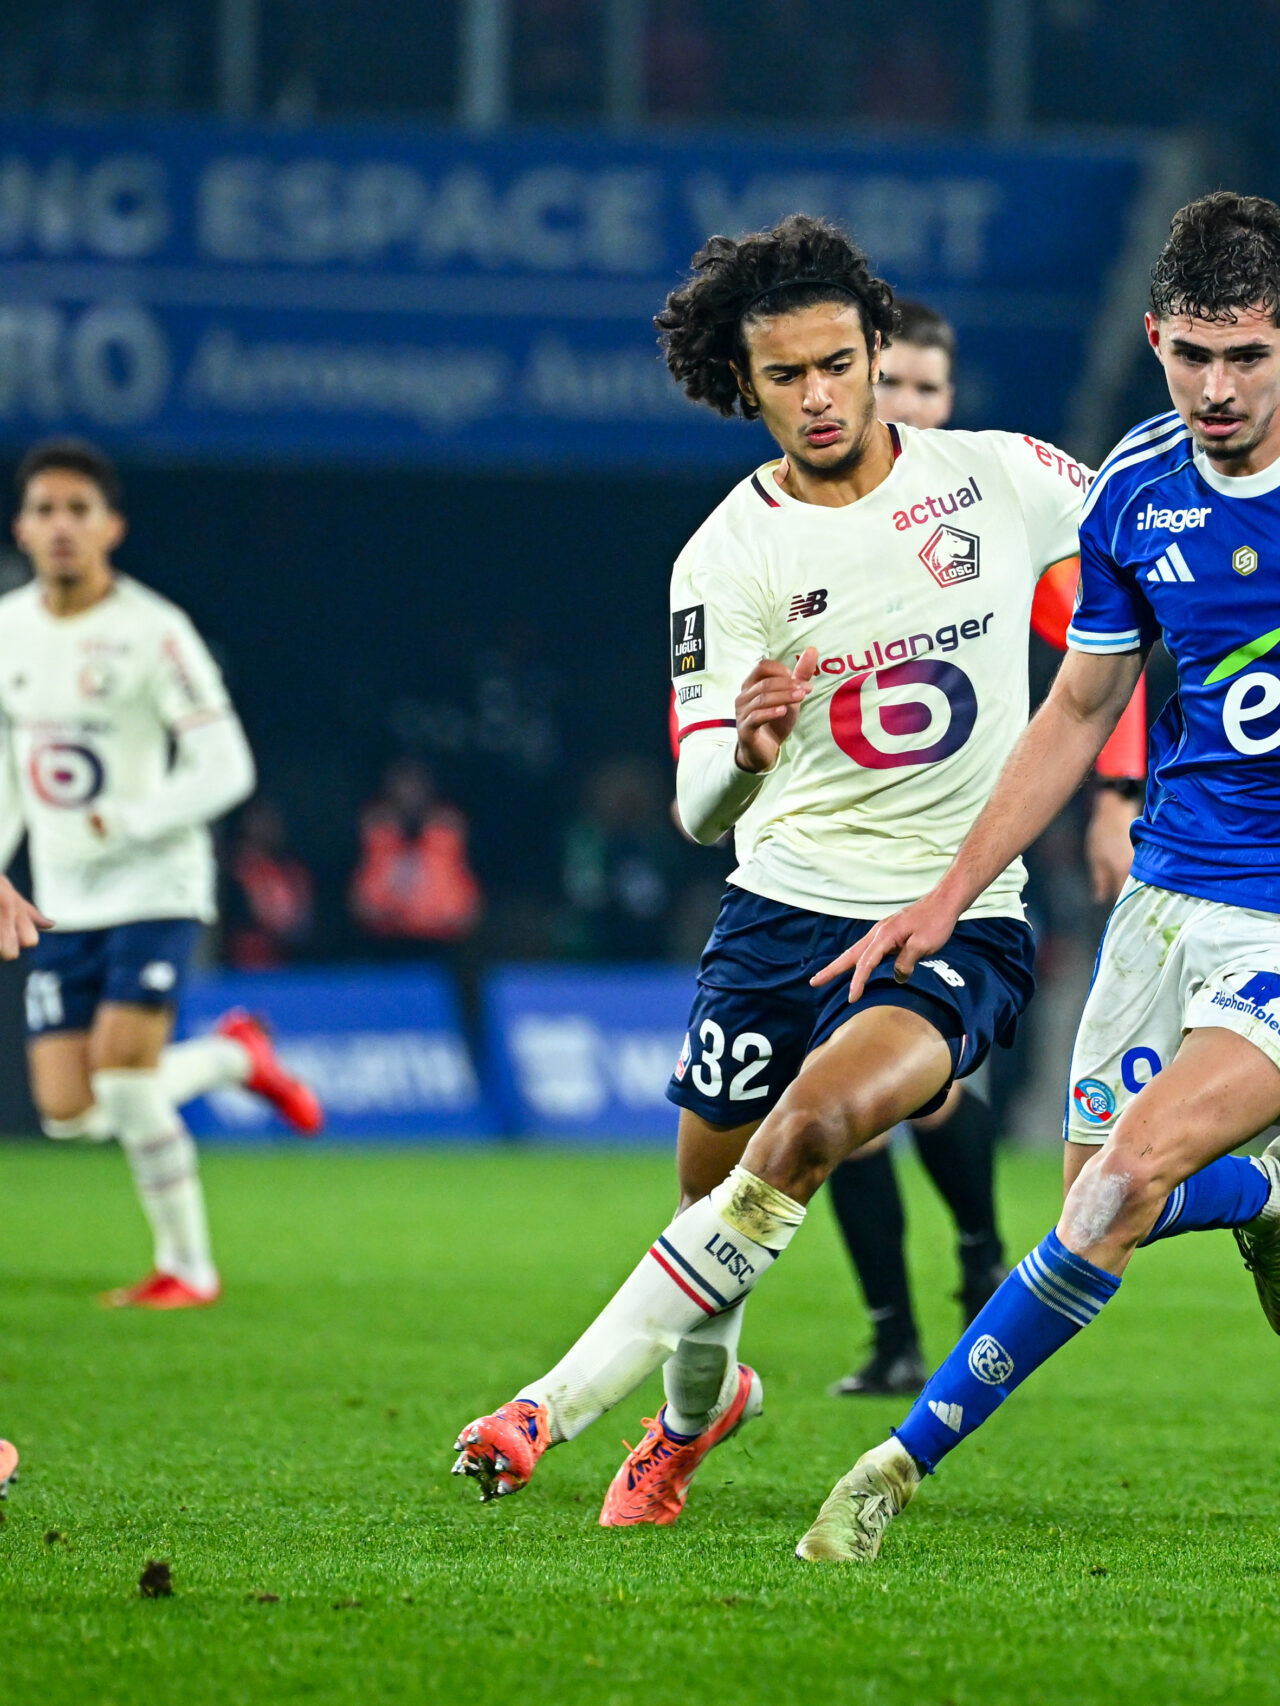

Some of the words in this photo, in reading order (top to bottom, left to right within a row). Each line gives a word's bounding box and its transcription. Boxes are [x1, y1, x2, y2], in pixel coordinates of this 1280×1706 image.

[200, 160, 666, 270] ESPACE
[892, 476, 983, 532] actual
[942, 563, 973, 581] LOSC
[675, 640, 697, 656] LIGUE
[796, 612, 994, 677] oulanger
[692, 1018, 773, 1101] 32
[704, 1233, 755, 1284] LOSC
